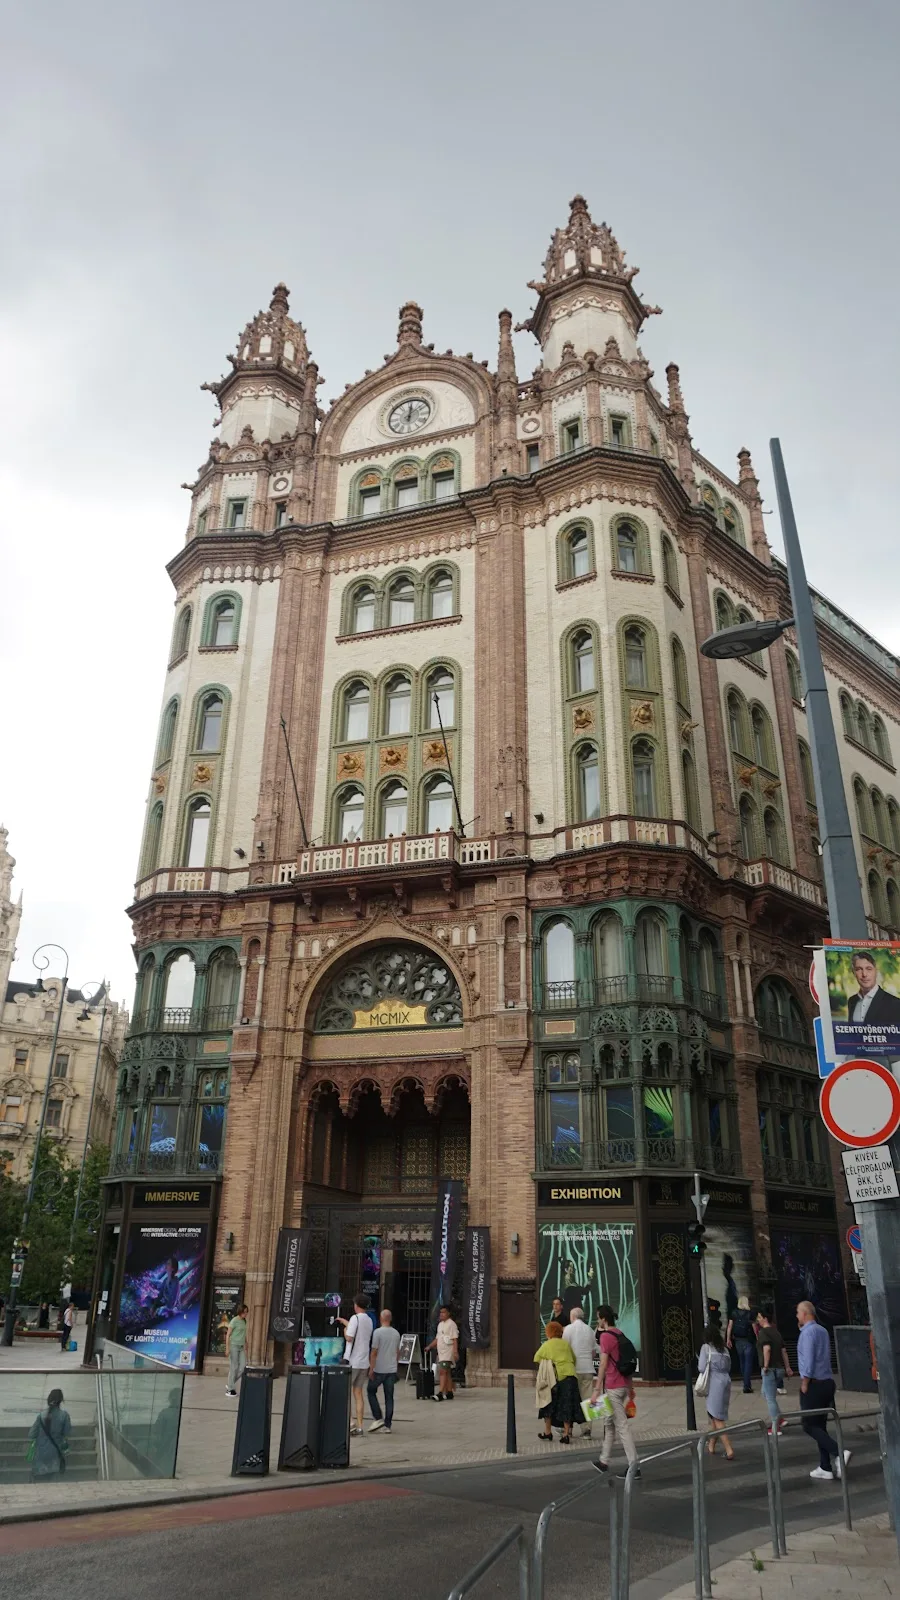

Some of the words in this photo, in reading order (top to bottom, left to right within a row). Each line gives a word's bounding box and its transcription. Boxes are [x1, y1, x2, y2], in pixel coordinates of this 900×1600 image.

[369, 1011, 410, 1026] MCMIX
[862, 1034, 888, 1043] PÉTER
[854, 1151, 879, 1163] KIVÉVE
[845, 1161, 893, 1176] CÉLFORGALOM
[874, 1172, 884, 1184] ÉS
[144, 1192, 200, 1202] IMMERSIVE
[550, 1187, 622, 1200] EXHIBITION
[855, 1184, 893, 1199] KERÉKPÁR
[784, 1200, 807, 1212] DIGITAL
[808, 1202, 820, 1213] ART
[287, 1237, 299, 1277] MYSTICA
[283, 1278, 293, 1314] CINEMA
[475, 1272, 485, 1323] INTERACTIVE
[134, 1335, 155, 1343] LIGHTS
